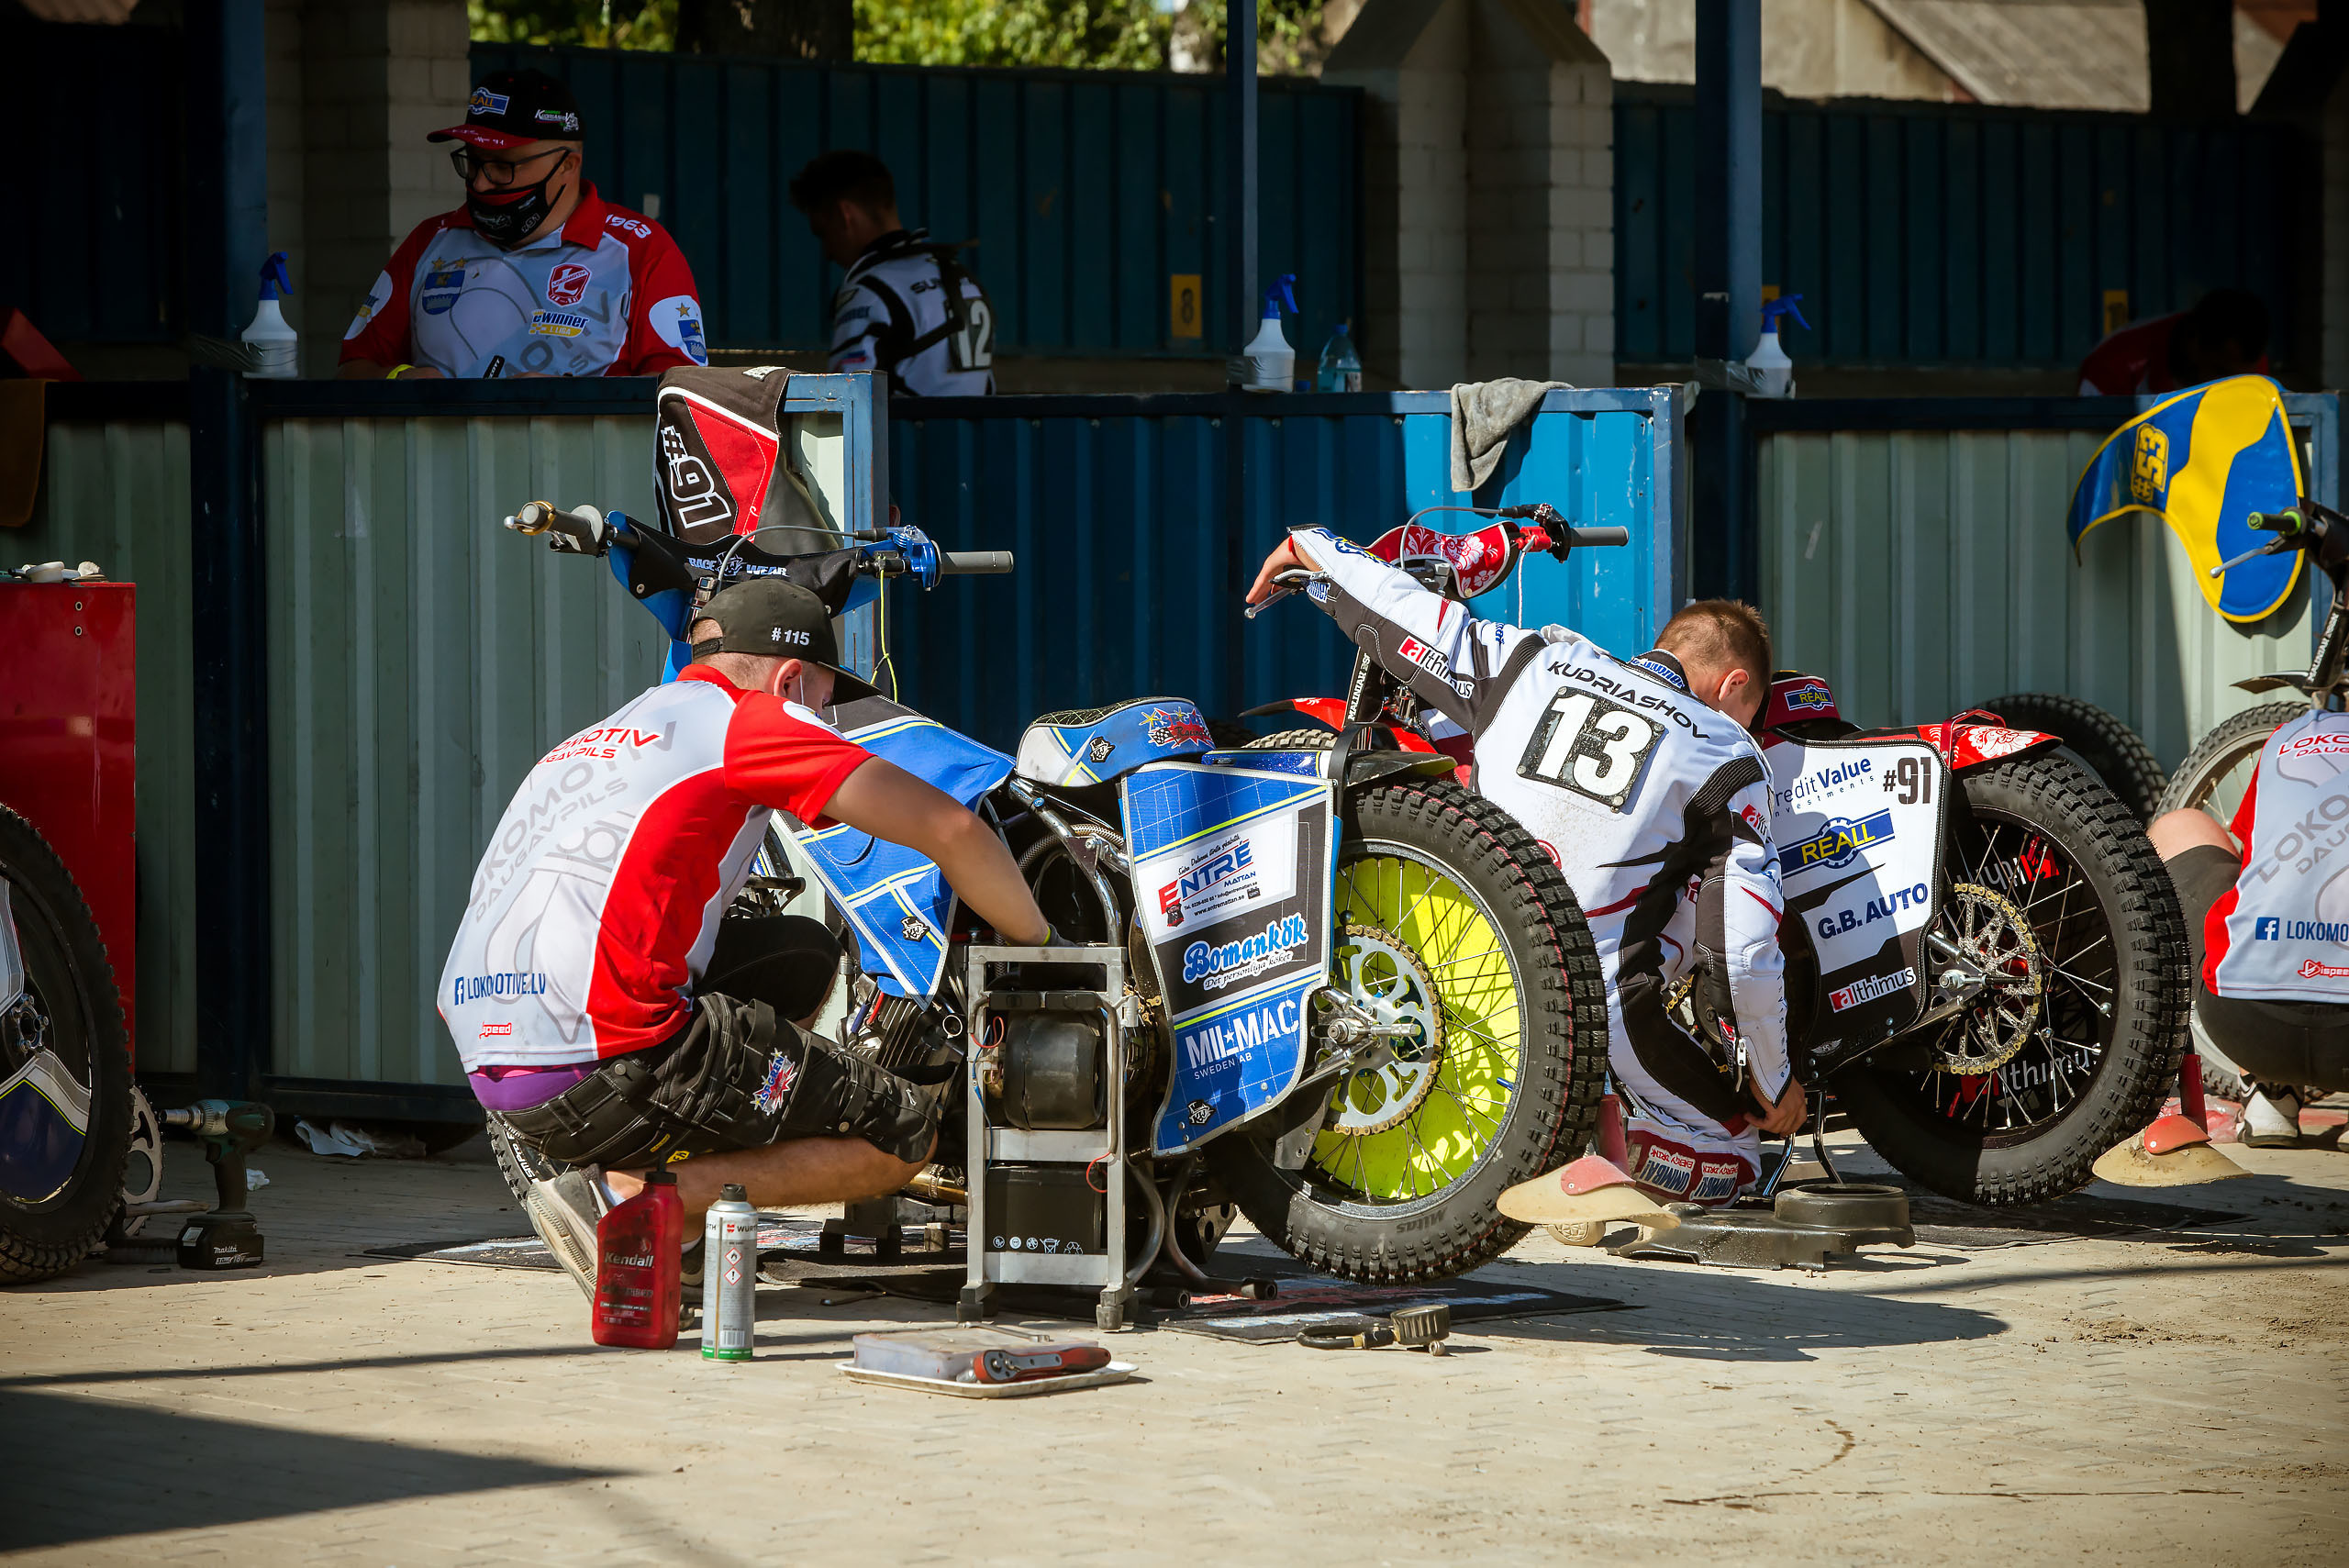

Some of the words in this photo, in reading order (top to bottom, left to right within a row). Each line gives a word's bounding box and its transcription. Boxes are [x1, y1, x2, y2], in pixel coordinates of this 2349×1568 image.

[605, 214, 652, 239] 1963
[1182, 288, 1194, 324] 8
[661, 426, 732, 529] #91
[2132, 426, 2166, 501] #53
[747, 564, 796, 576] WEAR
[1548, 661, 1710, 739] KUDRIASHOV
[1799, 692, 1829, 703] REALL
[1536, 694, 1653, 796] 13
[1883, 756, 1932, 806] #91
[1801, 823, 1876, 864] REALL
[1224, 871, 1256, 888] MATTAN
[1194, 895, 1245, 917] www.entremattan.se
[1818, 909, 1863, 940] G.B.
[1865, 883, 1929, 924] AUTO
[1185, 915, 1307, 981] Bomankök
[1206, 978, 1221, 988] Det
[1223, 963, 1266, 984] personliga
[1268, 952, 1291, 966] köket
[1833, 968, 1915, 1010] althimus
[759, 1056, 785, 1108] ASPGREN
[1194, 1058, 1235, 1080] SWEDEN
[1240, 1051, 1252, 1063] AB
[605, 1251, 654, 1268] Kendall
